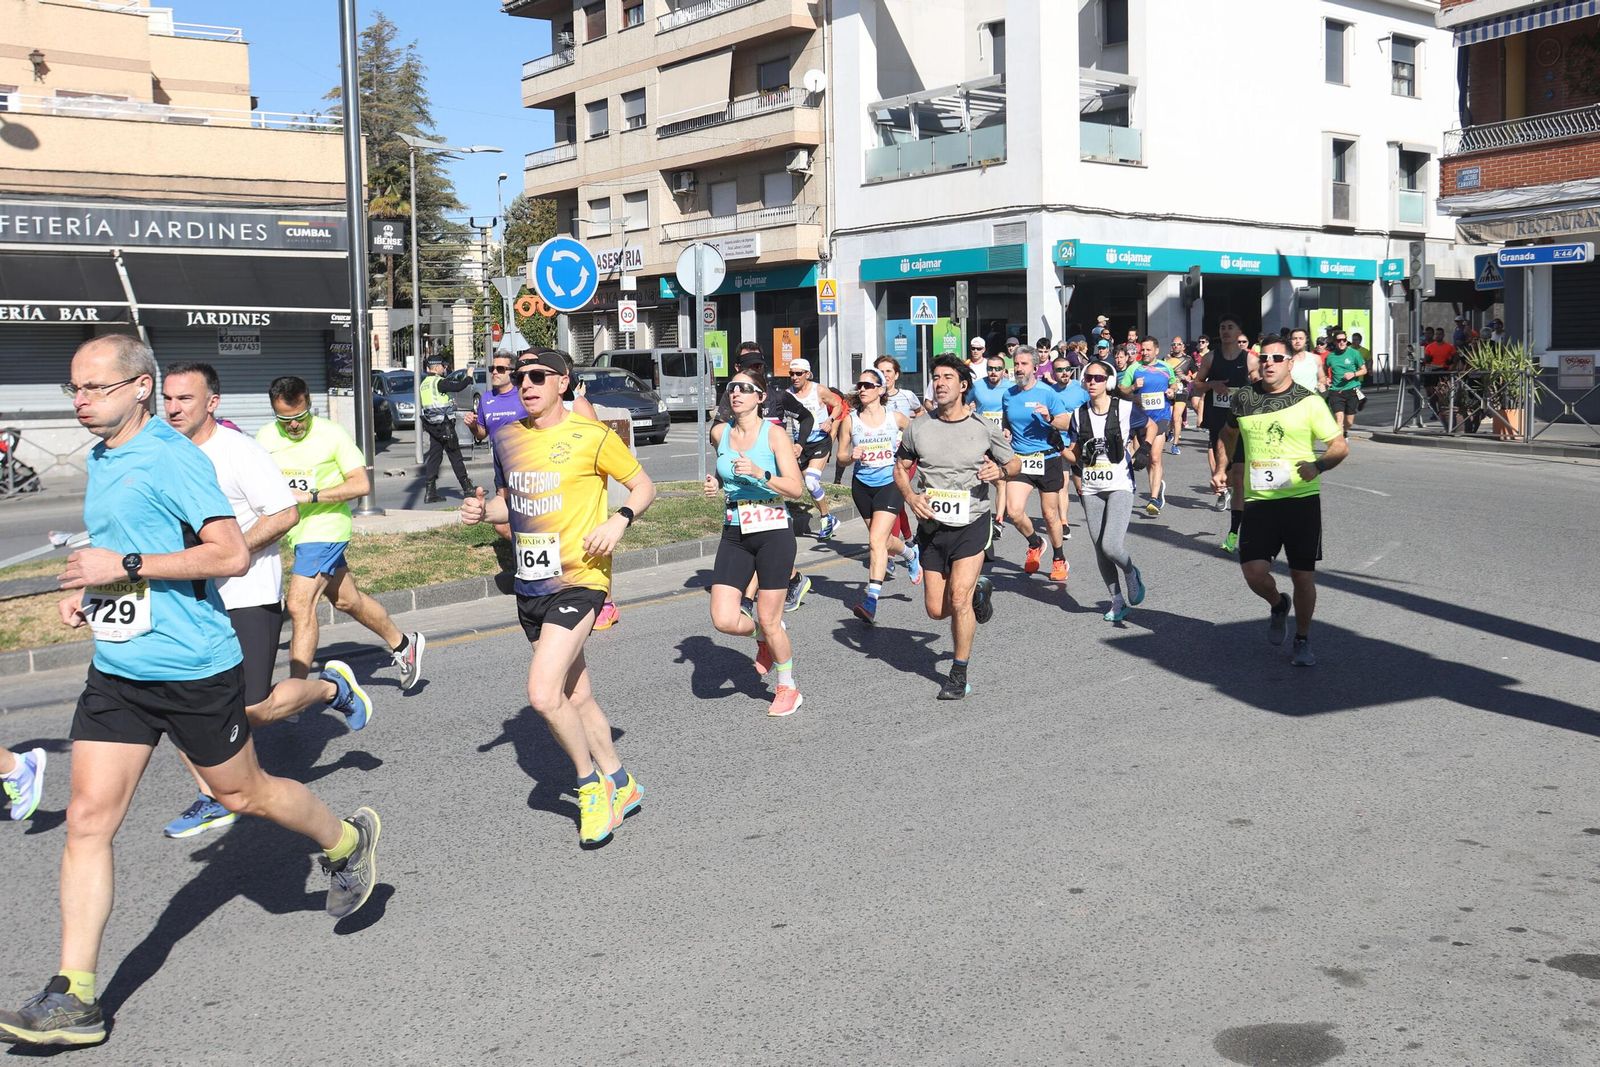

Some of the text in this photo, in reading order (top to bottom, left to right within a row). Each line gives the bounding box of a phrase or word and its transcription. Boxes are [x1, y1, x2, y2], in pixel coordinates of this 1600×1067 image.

[129, 221, 268, 241] JARDINES
[285, 227, 332, 238] CUMBAL
[1062, 247, 1073, 258] 24
[1118, 250, 1152, 265] cajamar
[1500, 252, 1535, 262] Granada
[911, 258, 943, 272] cajamar
[1231, 257, 1261, 270] cajamar
[1329, 262, 1356, 274] cajamar
[743, 275, 768, 287] cajamar
[58, 308, 100, 321] BAR
[187, 311, 271, 327] JARDINES
[1145, 398, 1162, 406] 880
[1022, 459, 1043, 469] 126
[508, 470, 561, 494] ATLETISMO
[1084, 470, 1113, 481] 3040
[1264, 470, 1274, 482] 3
[510, 493, 562, 517] ALHENDIN
[931, 500, 961, 515] 601
[741, 506, 786, 525] 2122
[88, 597, 137, 625] 729
